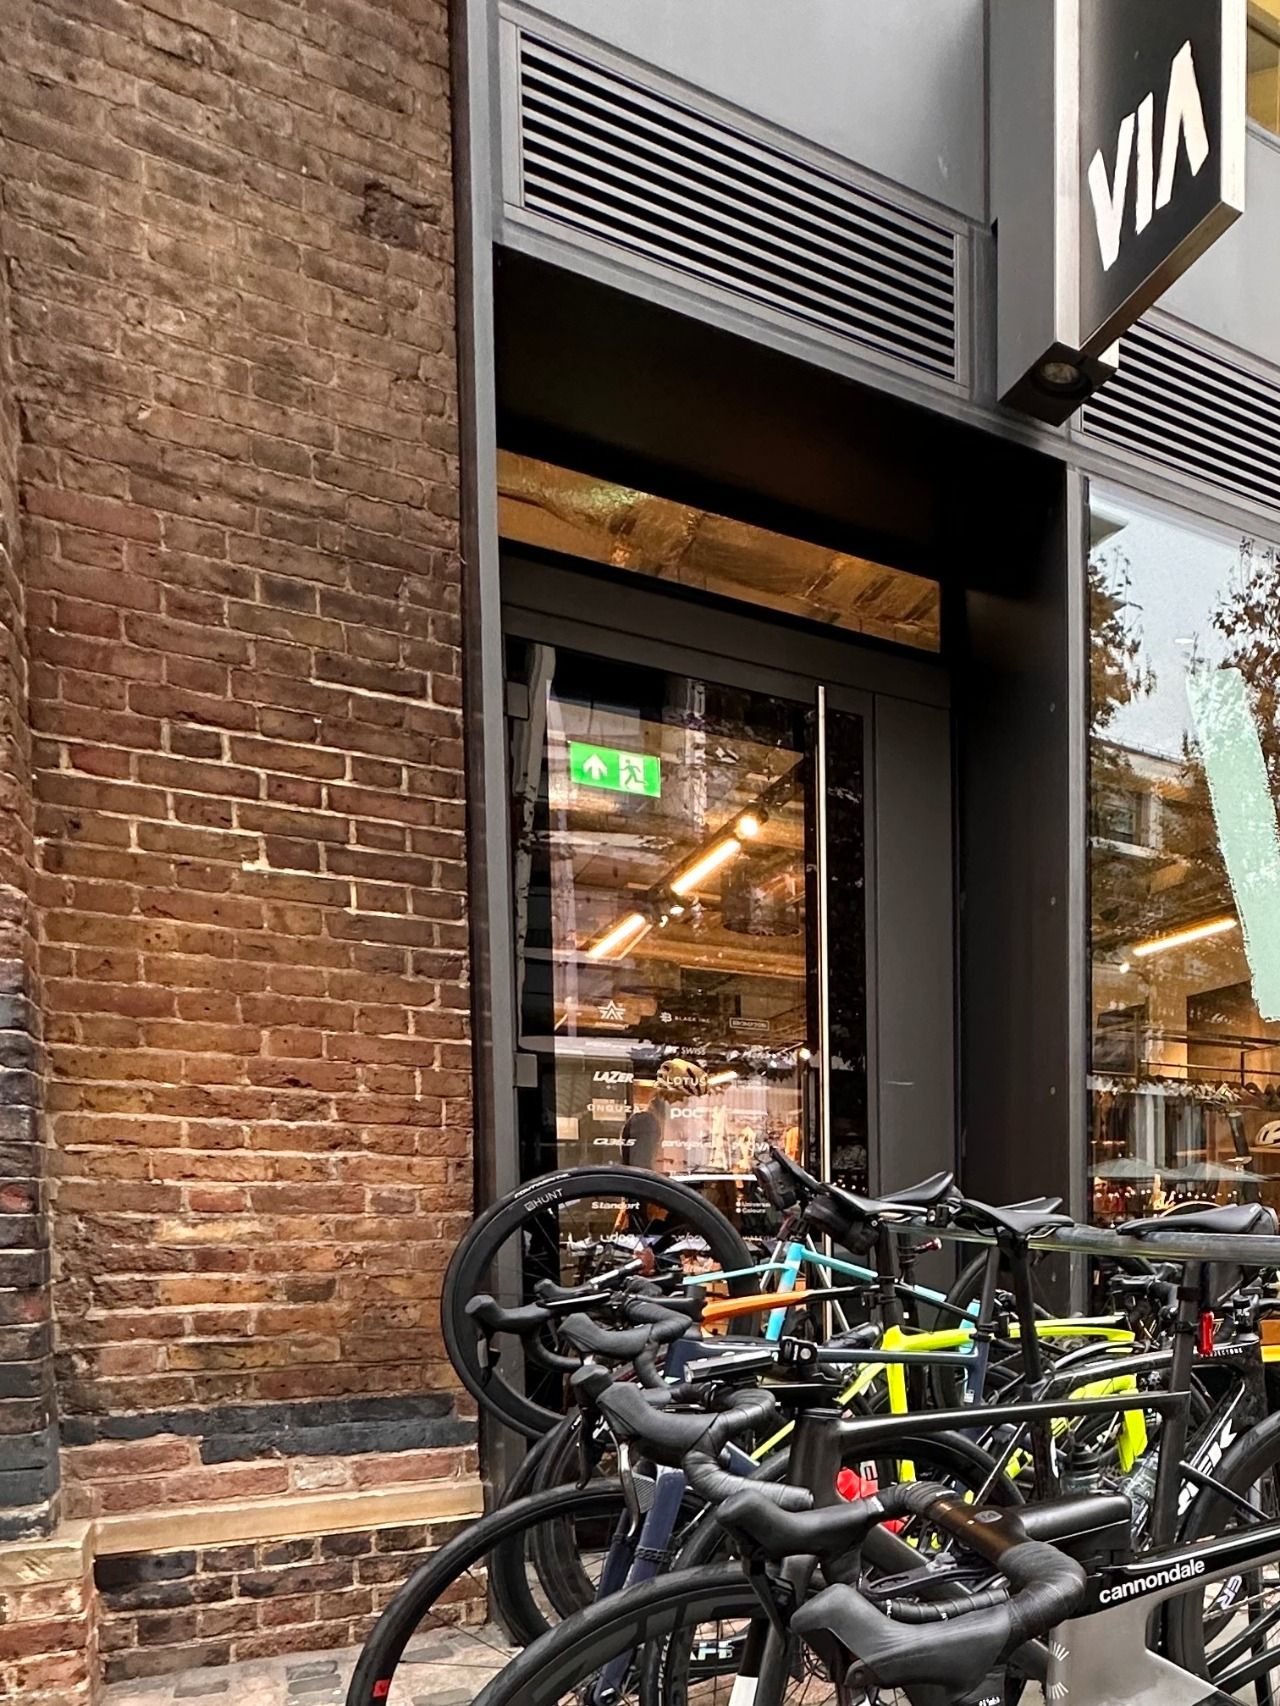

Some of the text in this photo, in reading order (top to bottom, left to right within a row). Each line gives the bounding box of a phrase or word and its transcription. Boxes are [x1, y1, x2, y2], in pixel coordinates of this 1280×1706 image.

[681, 1046, 706, 1056] SWISS
[592, 1070, 635, 1083] LAZER
[667, 1076, 708, 1088] LOTUS
[532, 1187, 563, 1208] HUNT
[1099, 1558, 1206, 1604] cannondale
